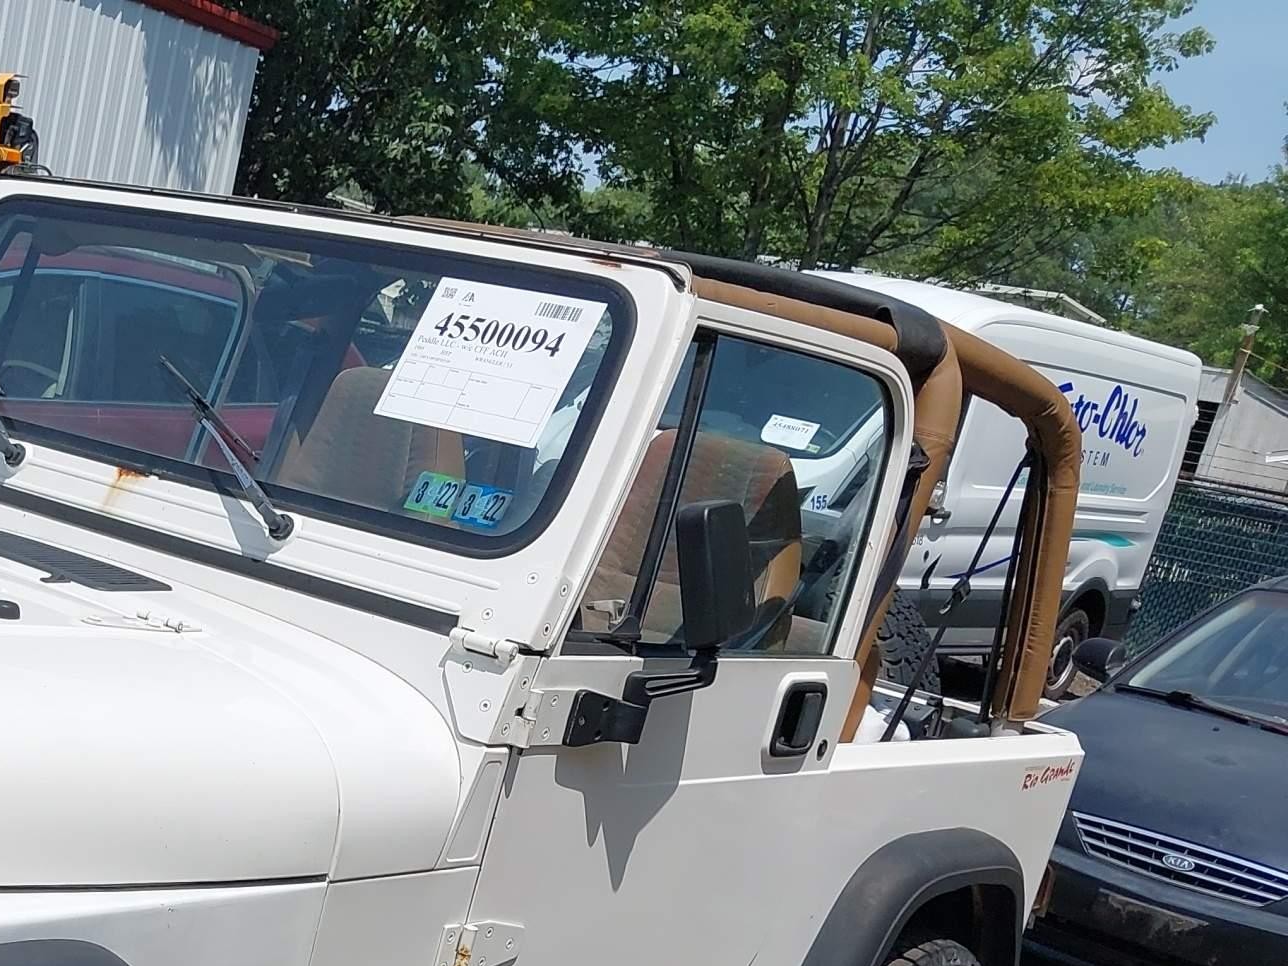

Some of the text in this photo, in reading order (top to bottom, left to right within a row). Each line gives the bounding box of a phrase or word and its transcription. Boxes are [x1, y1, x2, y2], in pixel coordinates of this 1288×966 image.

[434, 311, 566, 358] 45500094
[440, 339, 457, 348] LLC
[810, 495, 829, 511] 155
[1168, 856, 1189, 869] KIA
